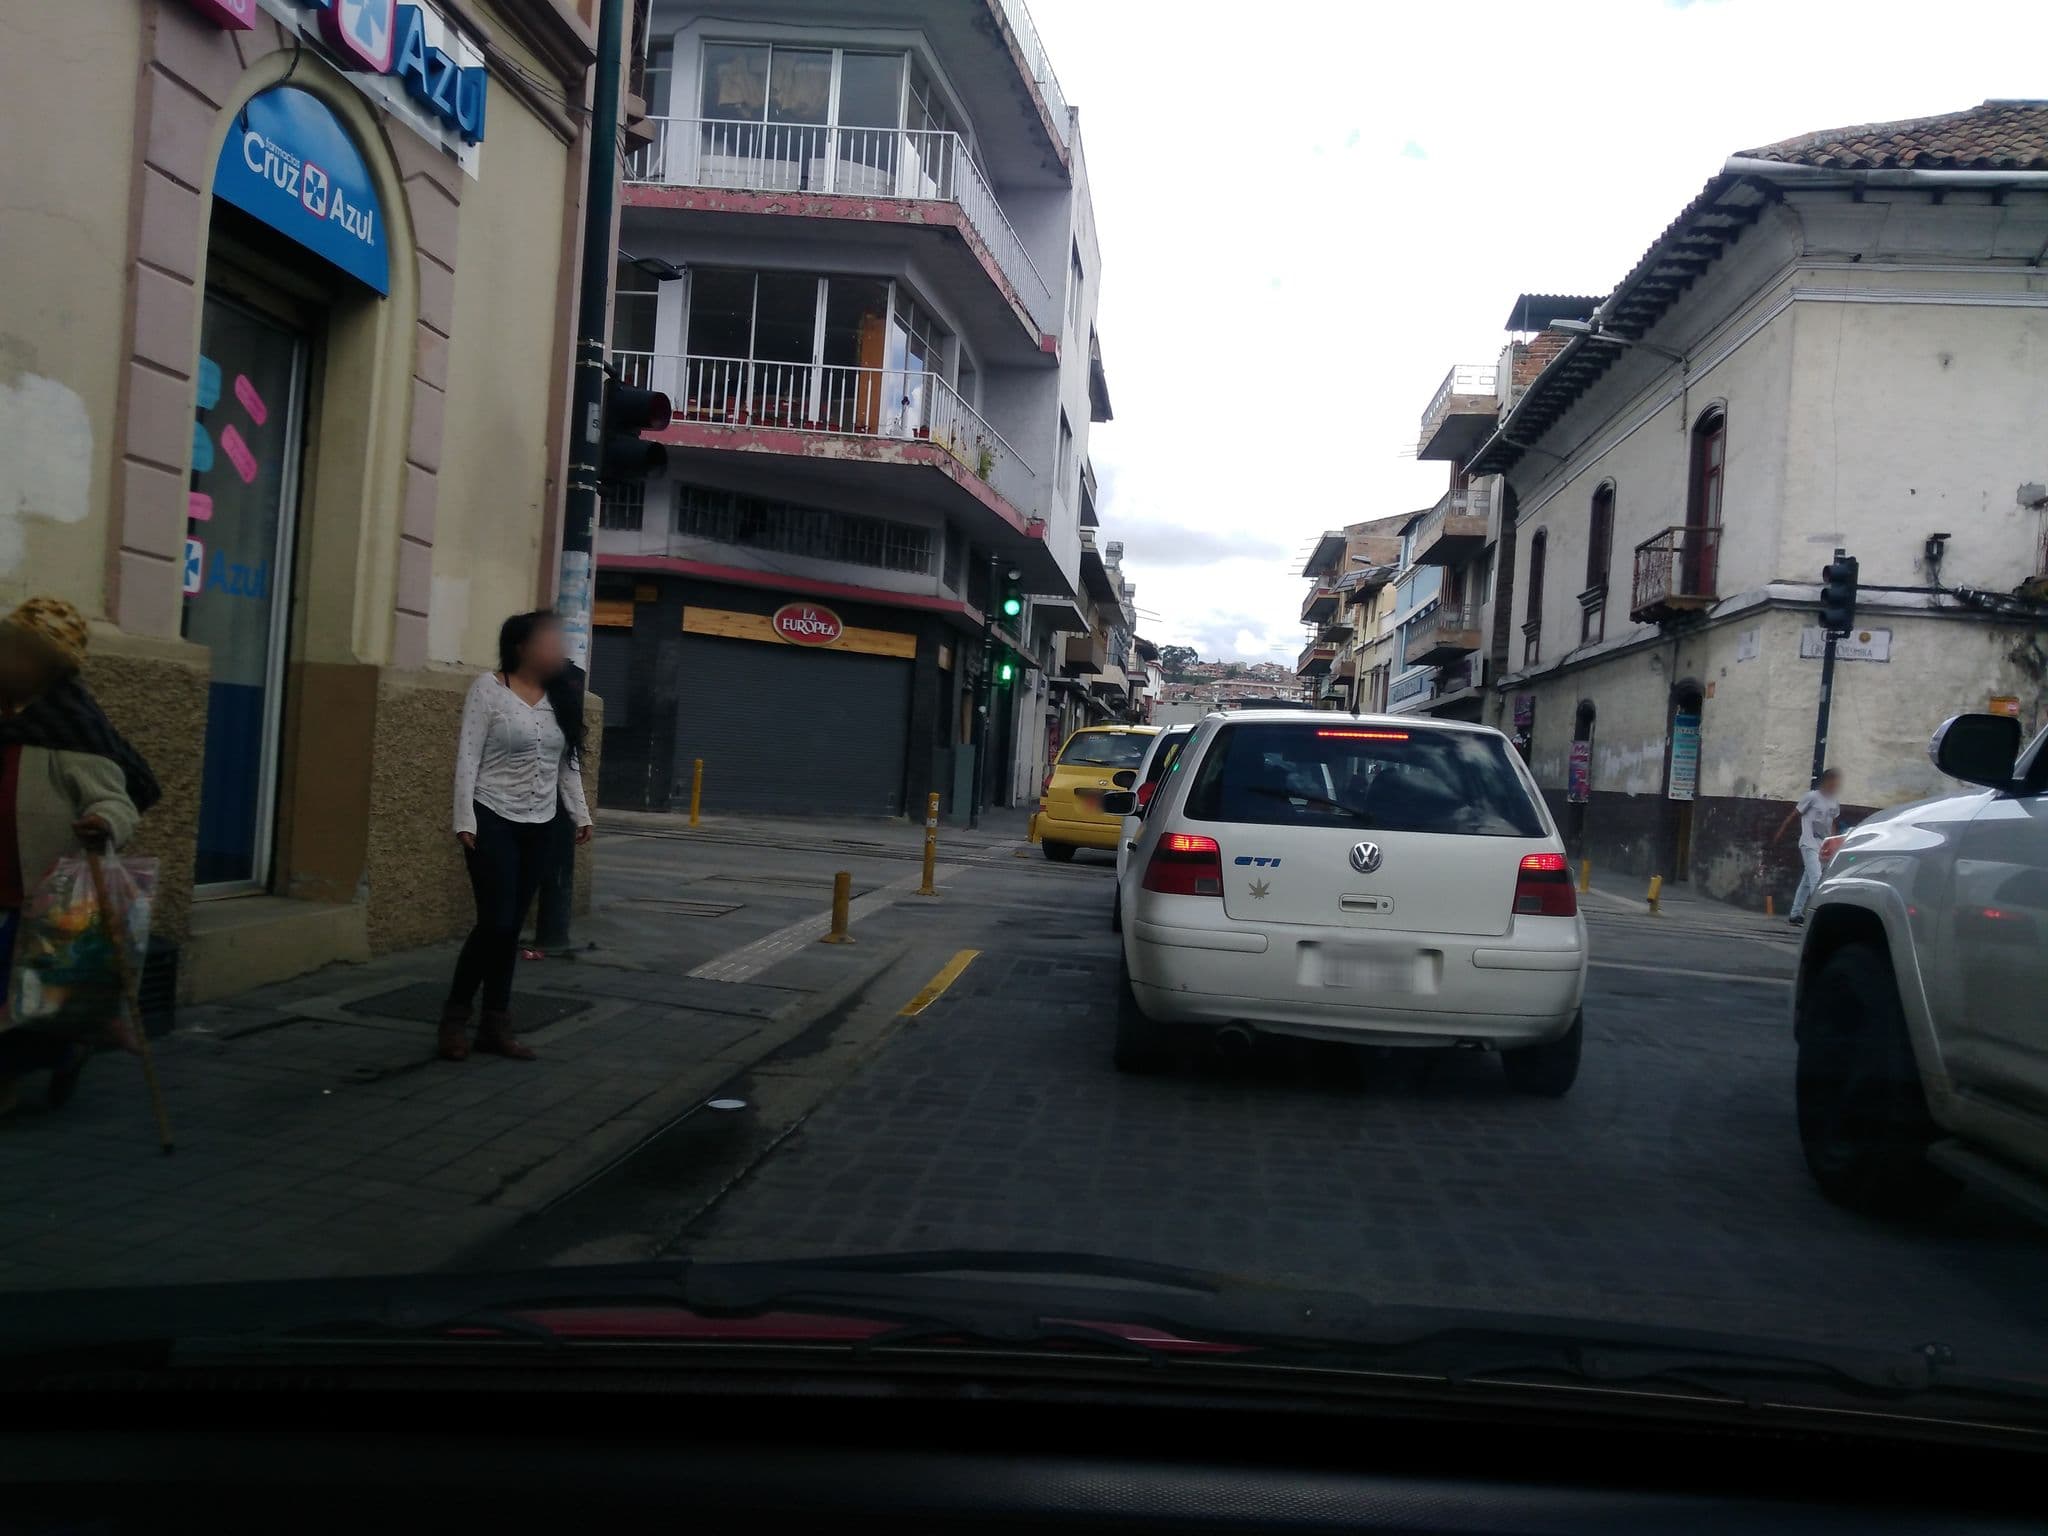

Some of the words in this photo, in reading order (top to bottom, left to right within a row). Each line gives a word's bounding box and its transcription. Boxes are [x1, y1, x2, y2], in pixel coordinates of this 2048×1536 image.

[244, 131, 300, 198] Cruz
[329, 187, 374, 245] Azul
[207, 545, 270, 599] Azul
[803, 608, 817, 620] LA
[782, 618, 835, 635] EUROPEA
[1234, 856, 1282, 868] GTI
